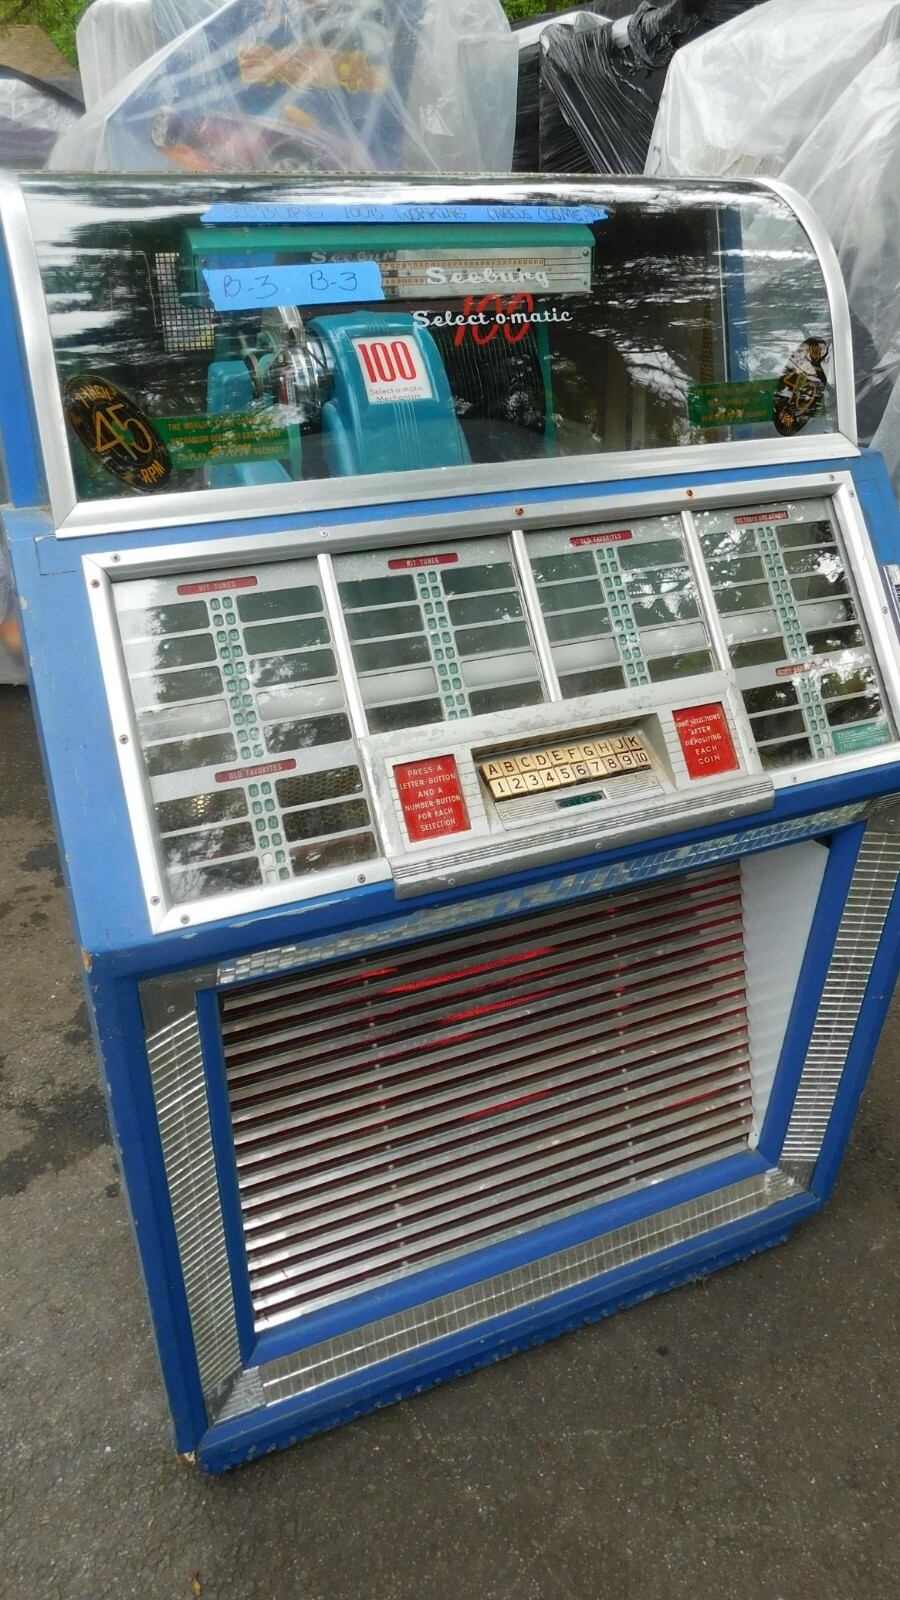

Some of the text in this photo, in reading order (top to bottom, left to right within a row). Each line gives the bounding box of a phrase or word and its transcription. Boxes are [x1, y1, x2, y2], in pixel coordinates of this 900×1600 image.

[425, 266, 551, 289] Seeburg
[412, 307, 573, 329] Select-o-matic
[358, 341, 417, 383] 100
[96, 403, 153, 461] 45
[140, 459, 165, 484] RPM
[198, 580, 237, 592] HIT TUNES
[690, 725, 712, 736] AFTER
[685, 733, 722, 747] DEPOSITING
[488, 736, 639, 775] A B C D E F G H J K
[695, 744, 718, 755] EACH
[698, 754, 720, 765] COIN
[228, 763, 283, 780] OLD FAVORITES
[407, 766, 433, 777] PRESS
[496, 752, 648, 793] 1 2 3 4 5 6 7 8 9 10
[399, 773, 456, 791] LETTER-BUTTON
[417, 788, 435, 798] AND
[404, 794, 461, 812] NUMBER-BUTTON
[417, 807, 453, 821] FOR EACH
[420, 818, 456, 832] SELECTION
